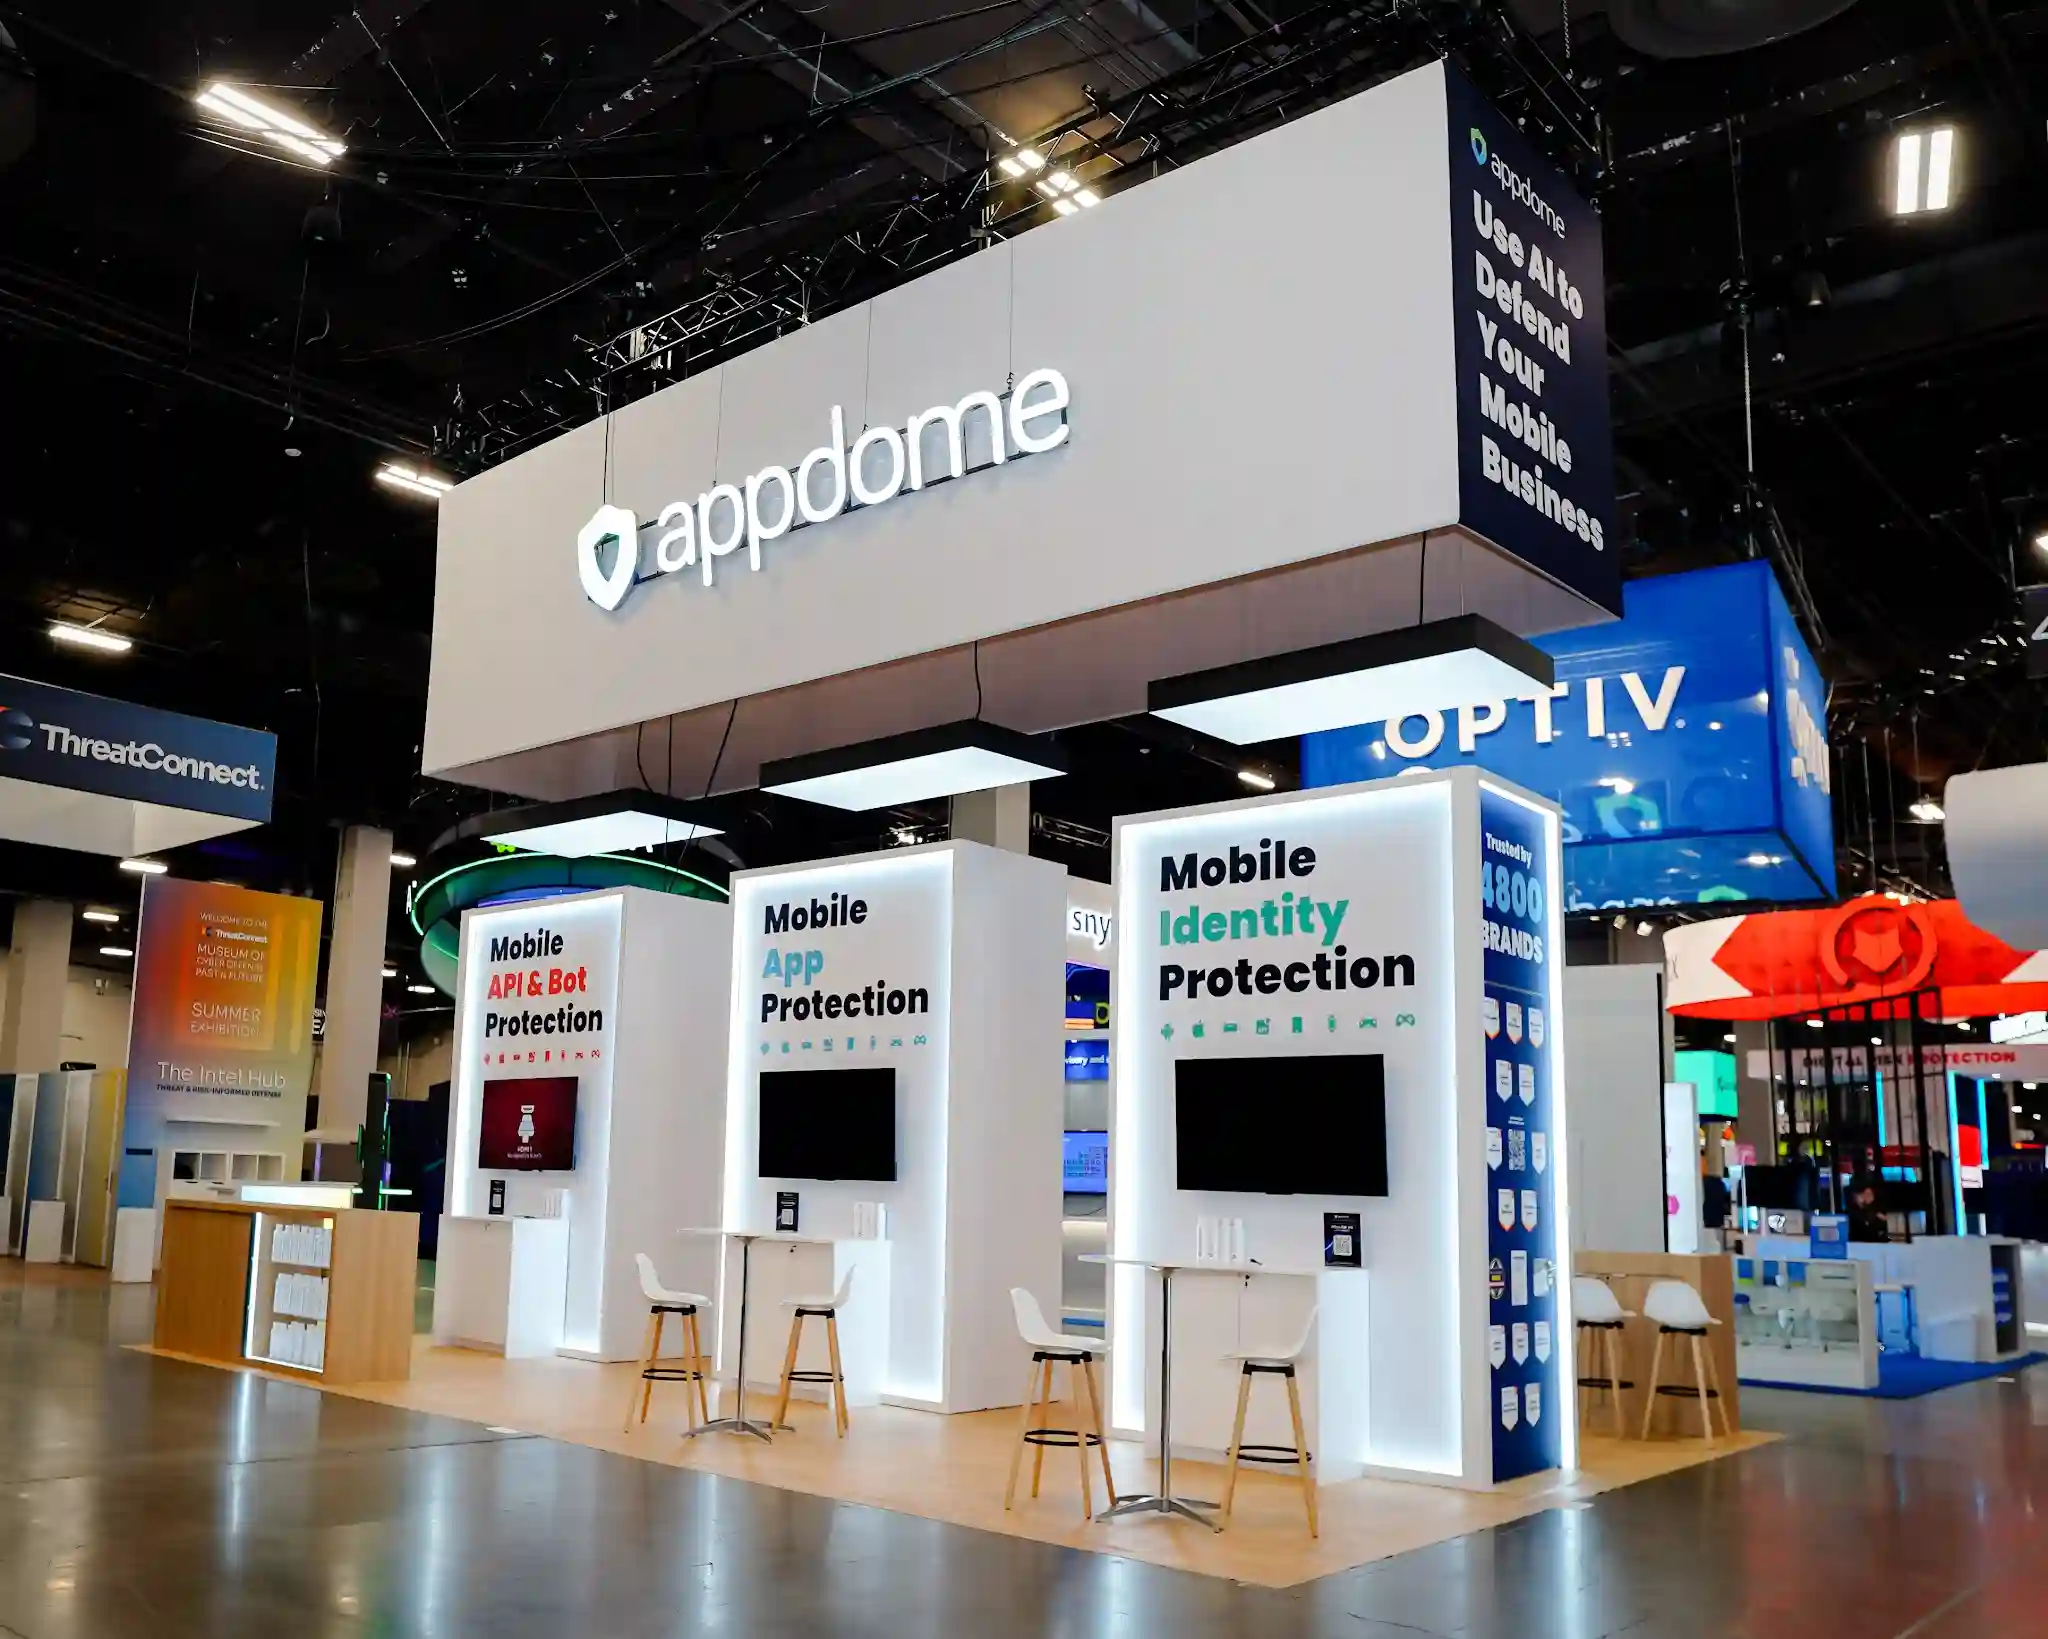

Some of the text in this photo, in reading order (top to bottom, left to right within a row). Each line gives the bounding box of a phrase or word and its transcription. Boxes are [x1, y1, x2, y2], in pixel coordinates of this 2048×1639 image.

[1491, 153, 1566, 239] appdome
[1473, 189, 1584, 319] Use AI to
[1475, 250, 1571, 365] Defend
[1476, 310, 1545, 397] Your
[1480, 372, 1572, 474] Mobile
[656, 368, 1071, 587] appdome
[1482, 434, 1604, 551] Business
[1160, 837, 1317, 892] Mobile
[1485, 832, 1533, 870] Trusted by
[764, 892, 868, 934] Mobile
[1482, 861, 1543, 924] 4800
[1159, 891, 1350, 947] Identity
[1482, 918, 1544, 964] BRANDS
[197, 943, 249, 959] MUSEUM
[490, 928, 564, 962] Mobile
[487, 966, 587, 1000] API & Bot
[762, 948, 824, 988] App
[1159, 944, 1415, 1001] Protection
[191, 1002, 261, 1021] SUMMER
[485, 1000, 603, 1038] Protection
[761, 979, 929, 1023] Protection
[190, 1020, 260, 1037] EXHIBITION
[156, 1083, 185, 1093] THREAT
[157, 1061, 286, 1089] The Intel Hub
